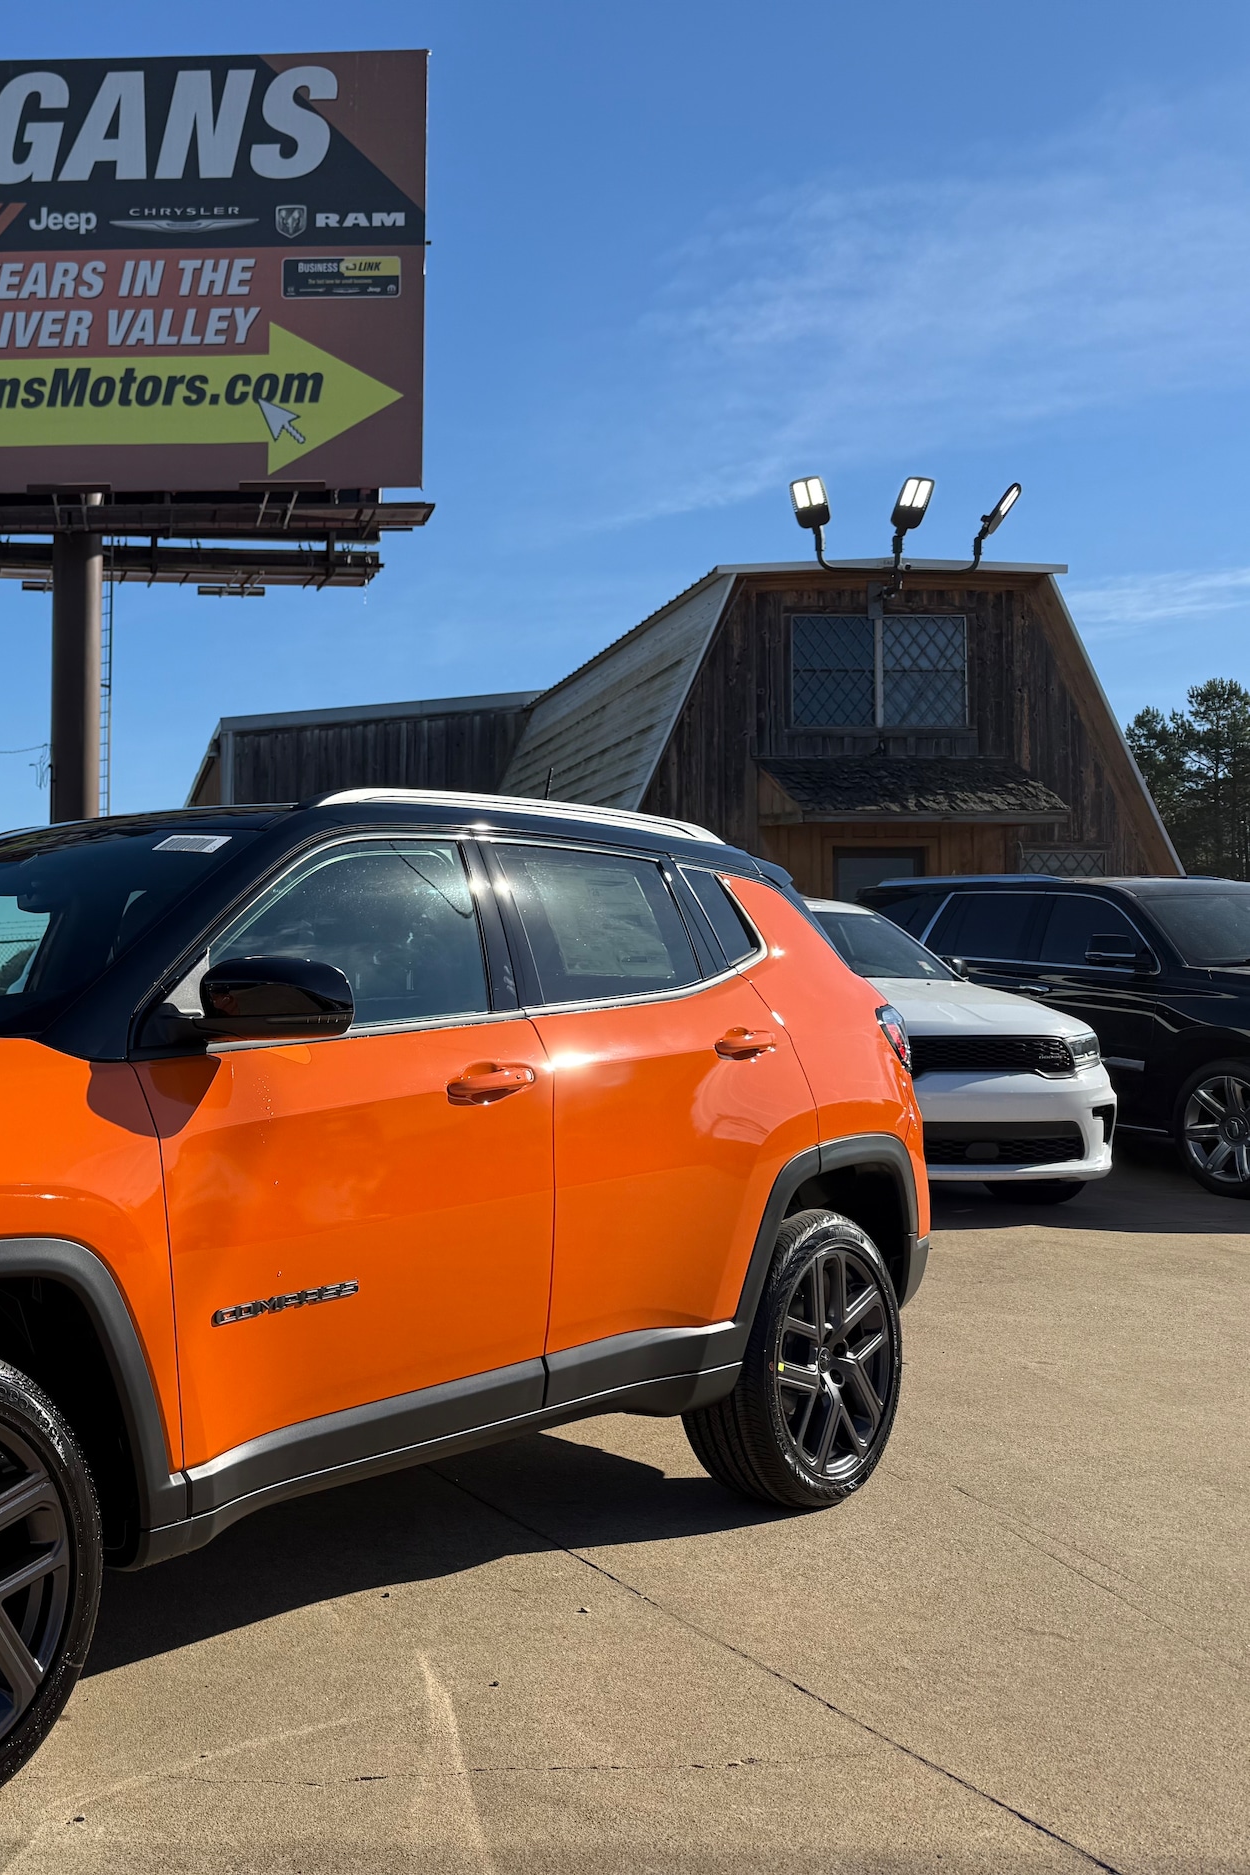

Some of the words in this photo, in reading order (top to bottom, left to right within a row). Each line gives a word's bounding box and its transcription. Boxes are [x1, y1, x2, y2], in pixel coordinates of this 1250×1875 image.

[29, 207, 97, 234] Jeep
[129, 206, 240, 217] CHRYSLER
[315, 211, 406, 228] RAM
[117, 259, 166, 298] IN
[172, 258, 255, 297] THE
[358, 261, 382, 272] LINK
[106, 306, 261, 347] VALLEY
[211, 1279, 359, 1328] COMPASS
